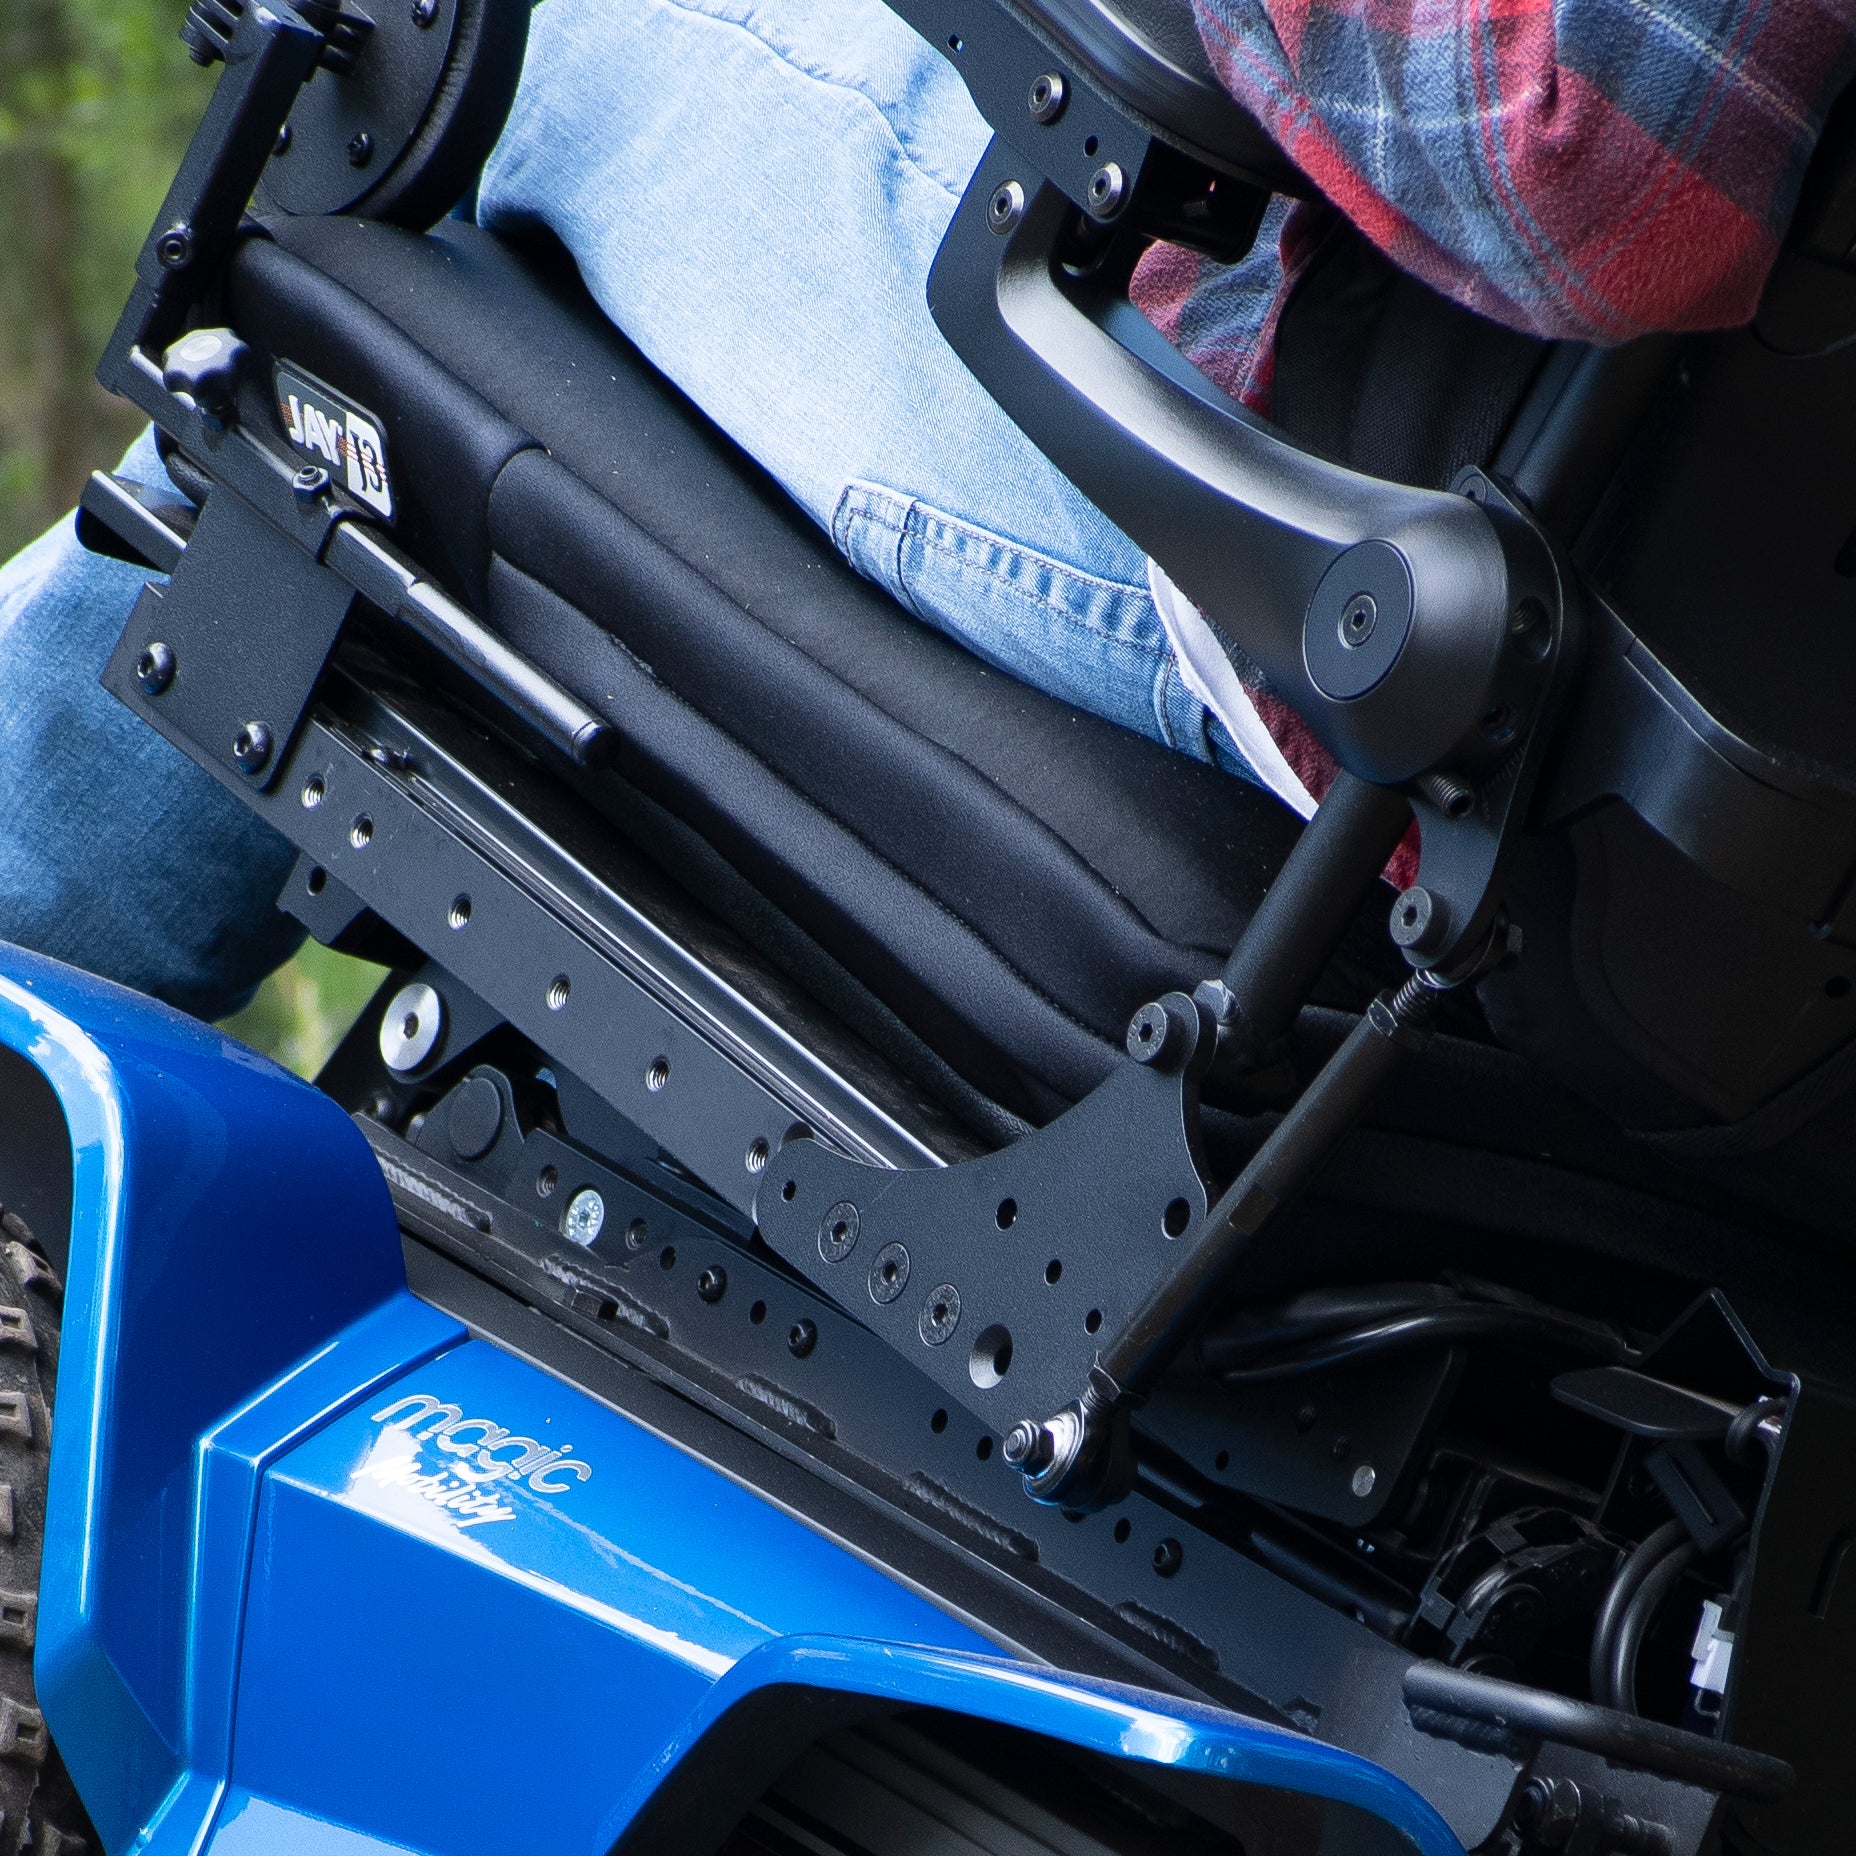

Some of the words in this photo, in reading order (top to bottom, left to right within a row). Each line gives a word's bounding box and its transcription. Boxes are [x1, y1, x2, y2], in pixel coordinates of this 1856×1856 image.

[288, 395, 342, 466] JAY
[371, 1394, 592, 1493] magic
[350, 1455, 516, 1527] Mobility
